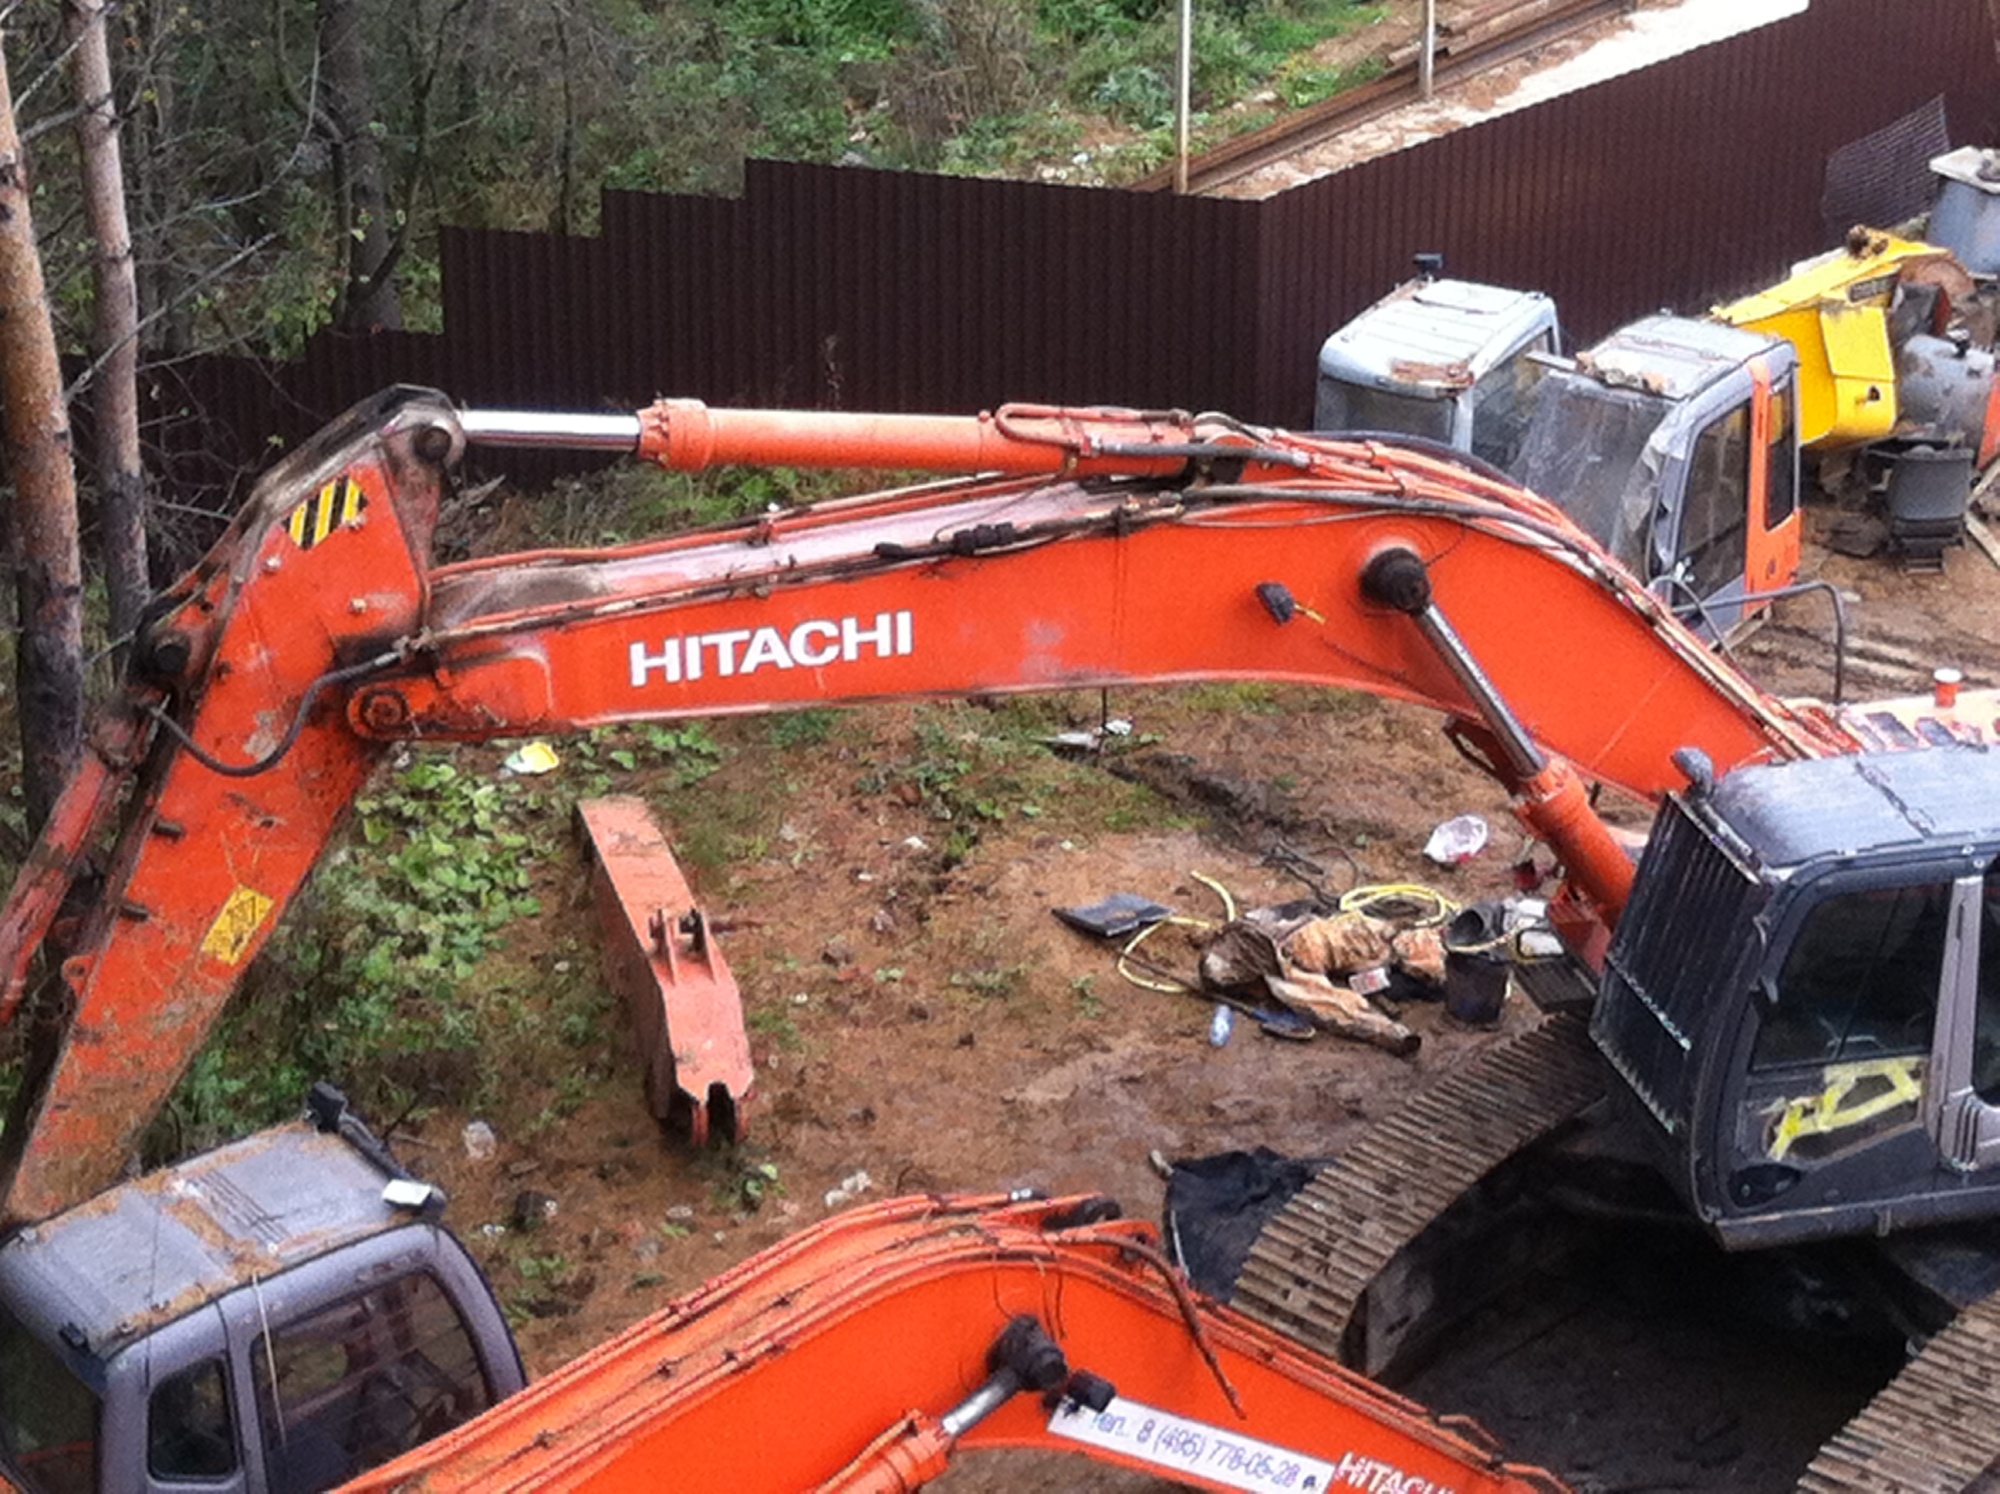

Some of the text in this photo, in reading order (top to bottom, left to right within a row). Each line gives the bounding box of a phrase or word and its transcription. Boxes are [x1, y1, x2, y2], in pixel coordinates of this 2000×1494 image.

[629, 611, 912, 687] HITACHI
[1137, 1419, 1155, 1443] 8
[1335, 1452, 1455, 1494] HITAC
